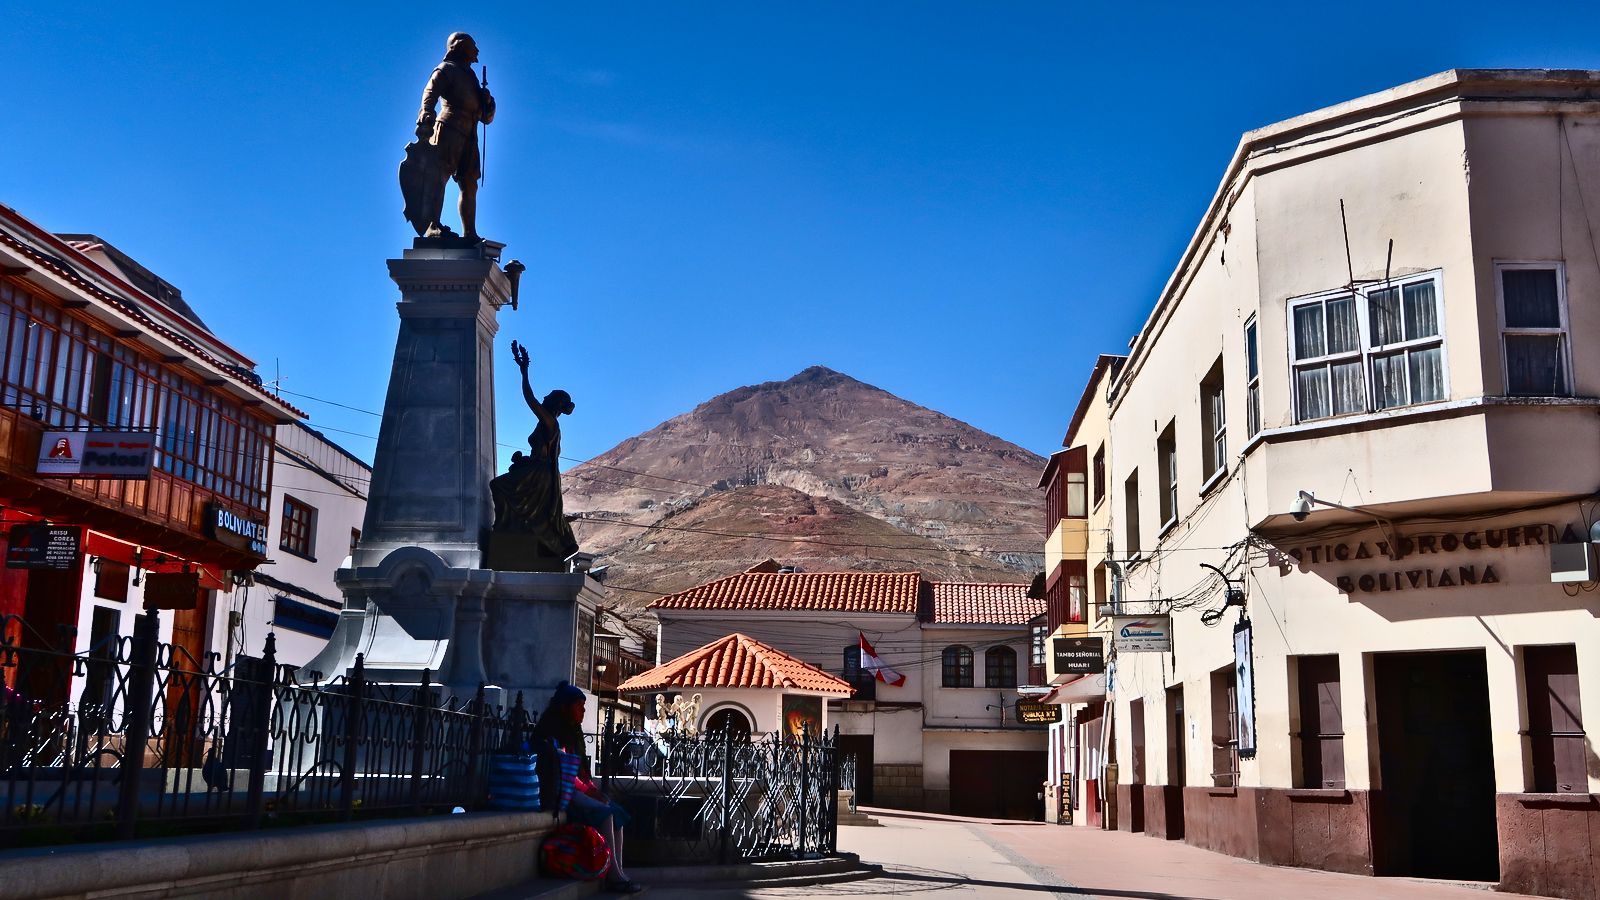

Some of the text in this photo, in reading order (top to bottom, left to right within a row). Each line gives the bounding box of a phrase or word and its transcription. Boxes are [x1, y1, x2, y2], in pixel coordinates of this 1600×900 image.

[84, 451, 148, 467] Potosí
[218, 509, 268, 542] BOLIVIATEL
[1396, 523, 1580, 557] DROGUERIA
[1336, 564, 1499, 594] BOLIVIANA
[1062, 774, 1070, 816] NOTARIA
